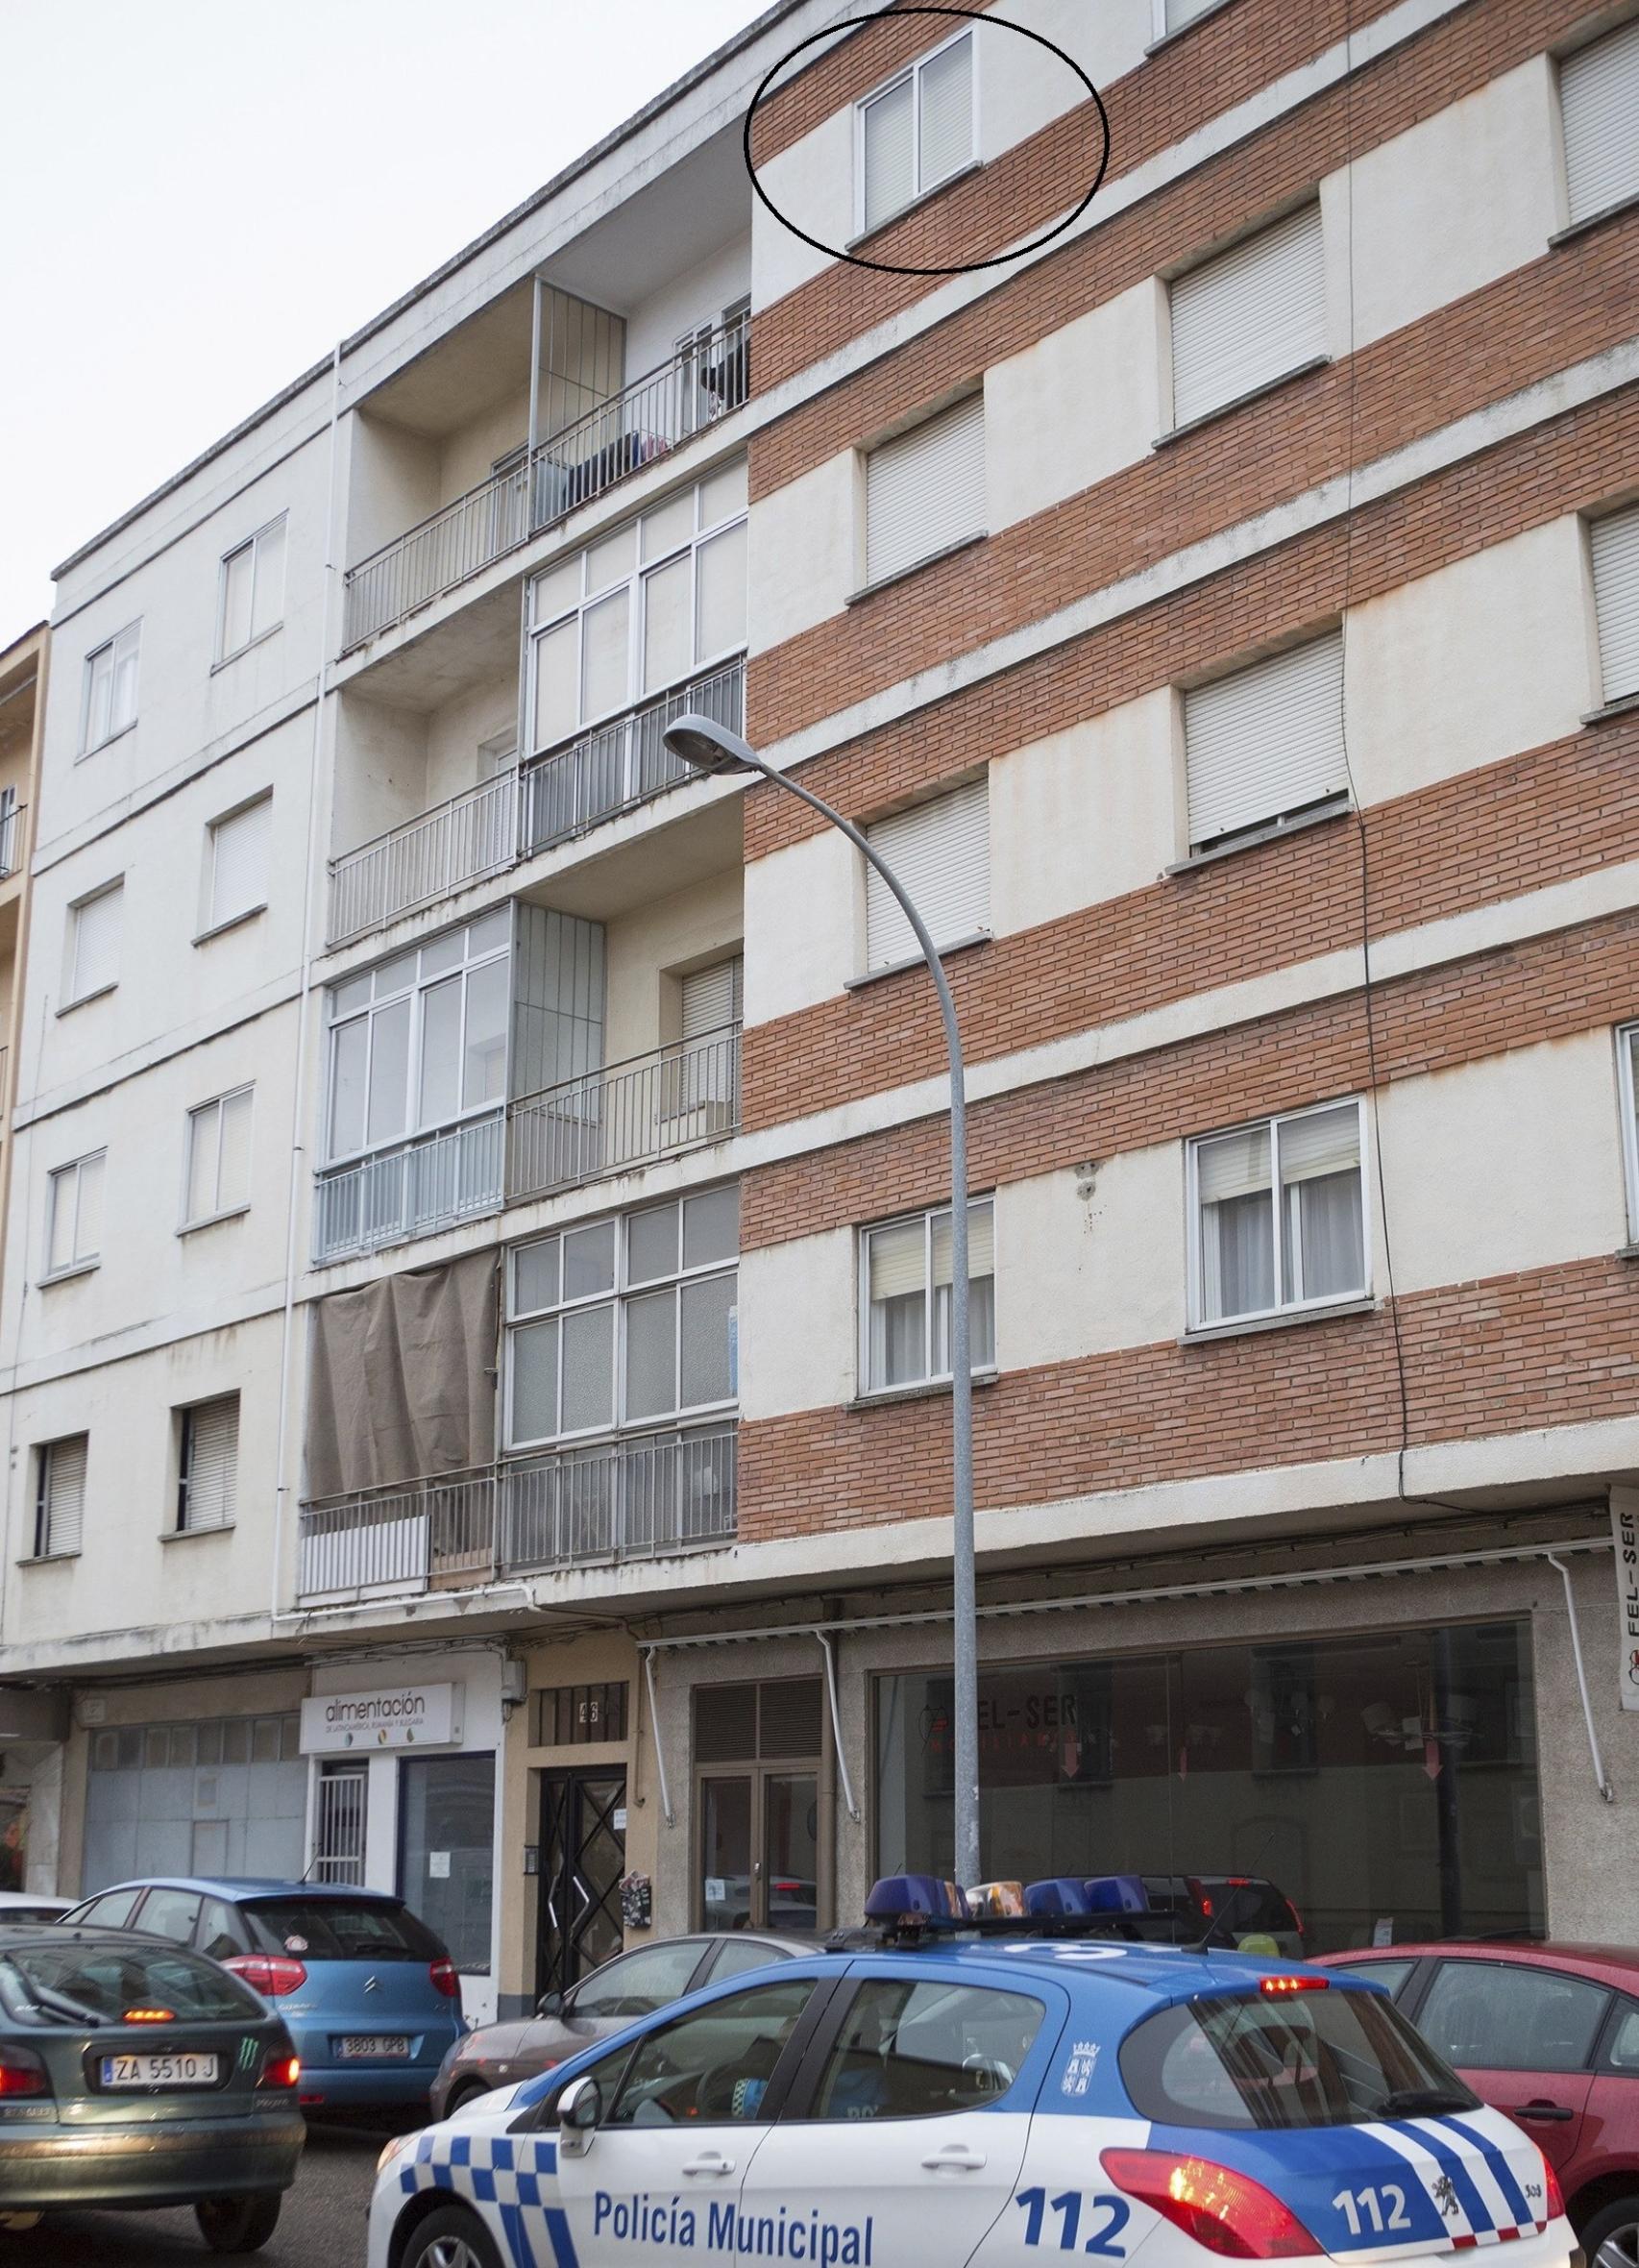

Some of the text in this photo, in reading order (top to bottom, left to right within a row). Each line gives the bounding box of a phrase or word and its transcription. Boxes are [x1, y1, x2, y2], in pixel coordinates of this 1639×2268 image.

[1620, 1512, 1639, 1638] FEL-SER
[326, 1691, 426, 1722] alimentación
[977, 1694, 1077, 1730] EL-SER
[345, 2037, 377, 2053] 3803
[116, 2058, 214, 2081] ZA 5510 J
[594, 2190, 873, 2268] Policía Municipal
[1015, 2186, 1131, 2258] 112
[1332, 2183, 1412, 2235] 112
